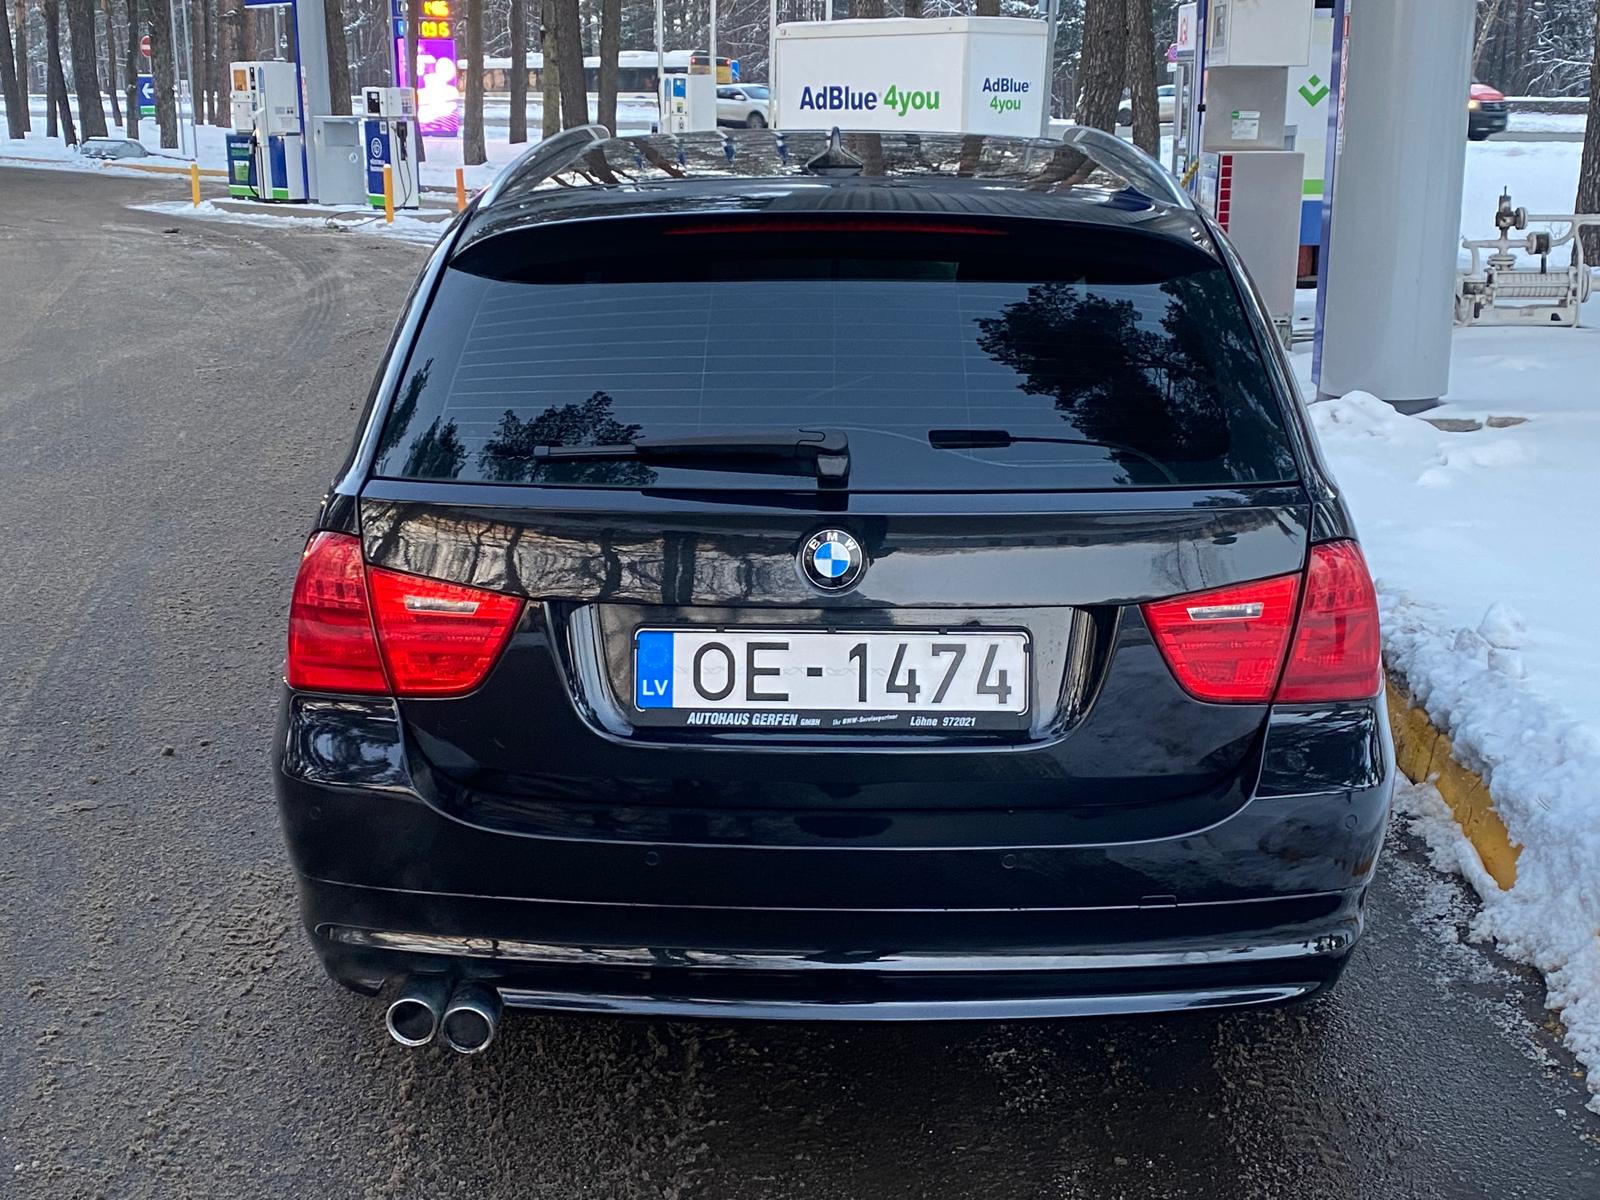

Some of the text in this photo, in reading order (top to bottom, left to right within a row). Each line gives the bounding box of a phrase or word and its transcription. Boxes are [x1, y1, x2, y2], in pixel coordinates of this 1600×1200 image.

[982, 77, 1029, 93] AdBlue
[799, 84, 940, 117] AdBlue 4you
[990, 95, 1021, 114] 4you
[808, 531, 857, 551] BMW
[642, 679, 669, 696] LV
[687, 711, 750, 725] AUTOHAUS
[752, 712, 798, 726] GERFEN
[910, 715, 938, 726] Löhne
[942, 716, 977, 727] 972021
